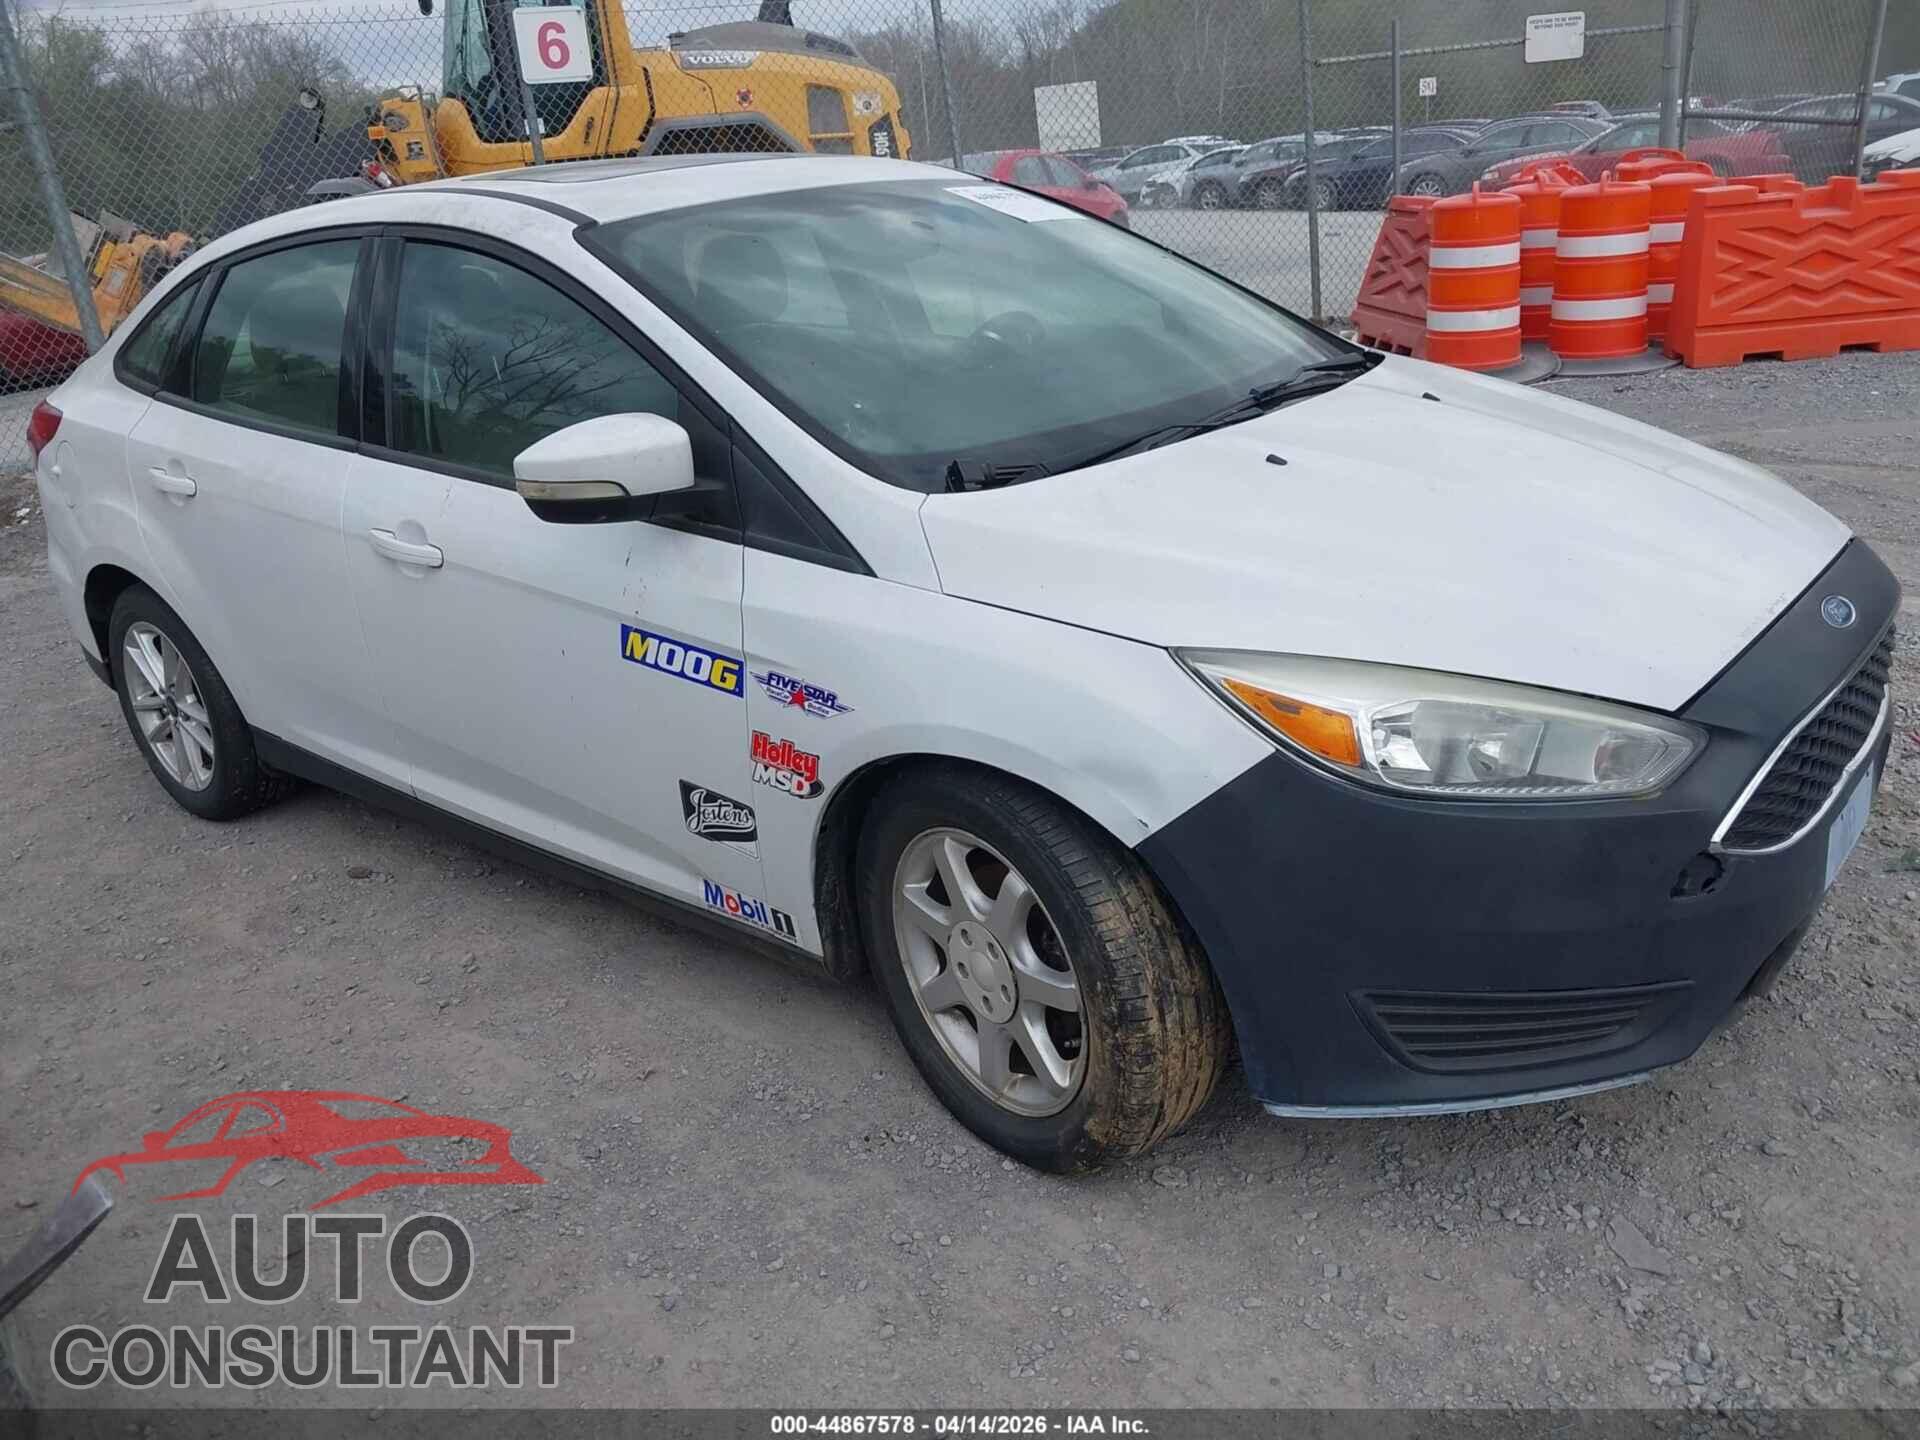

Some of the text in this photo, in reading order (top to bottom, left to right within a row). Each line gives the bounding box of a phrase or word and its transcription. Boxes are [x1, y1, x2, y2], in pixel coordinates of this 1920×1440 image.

[537, 21, 570, 70] 6
[688, 55, 750, 65] VOLVO
[625, 631, 740, 691] MOOG
[767, 672, 838, 709] FIVE STAR
[751, 730, 819, 783] Holley
[752, 762, 816, 797] MSD
[687, 788, 755, 833] Jostens
[703, 879, 768, 925] Mobil
